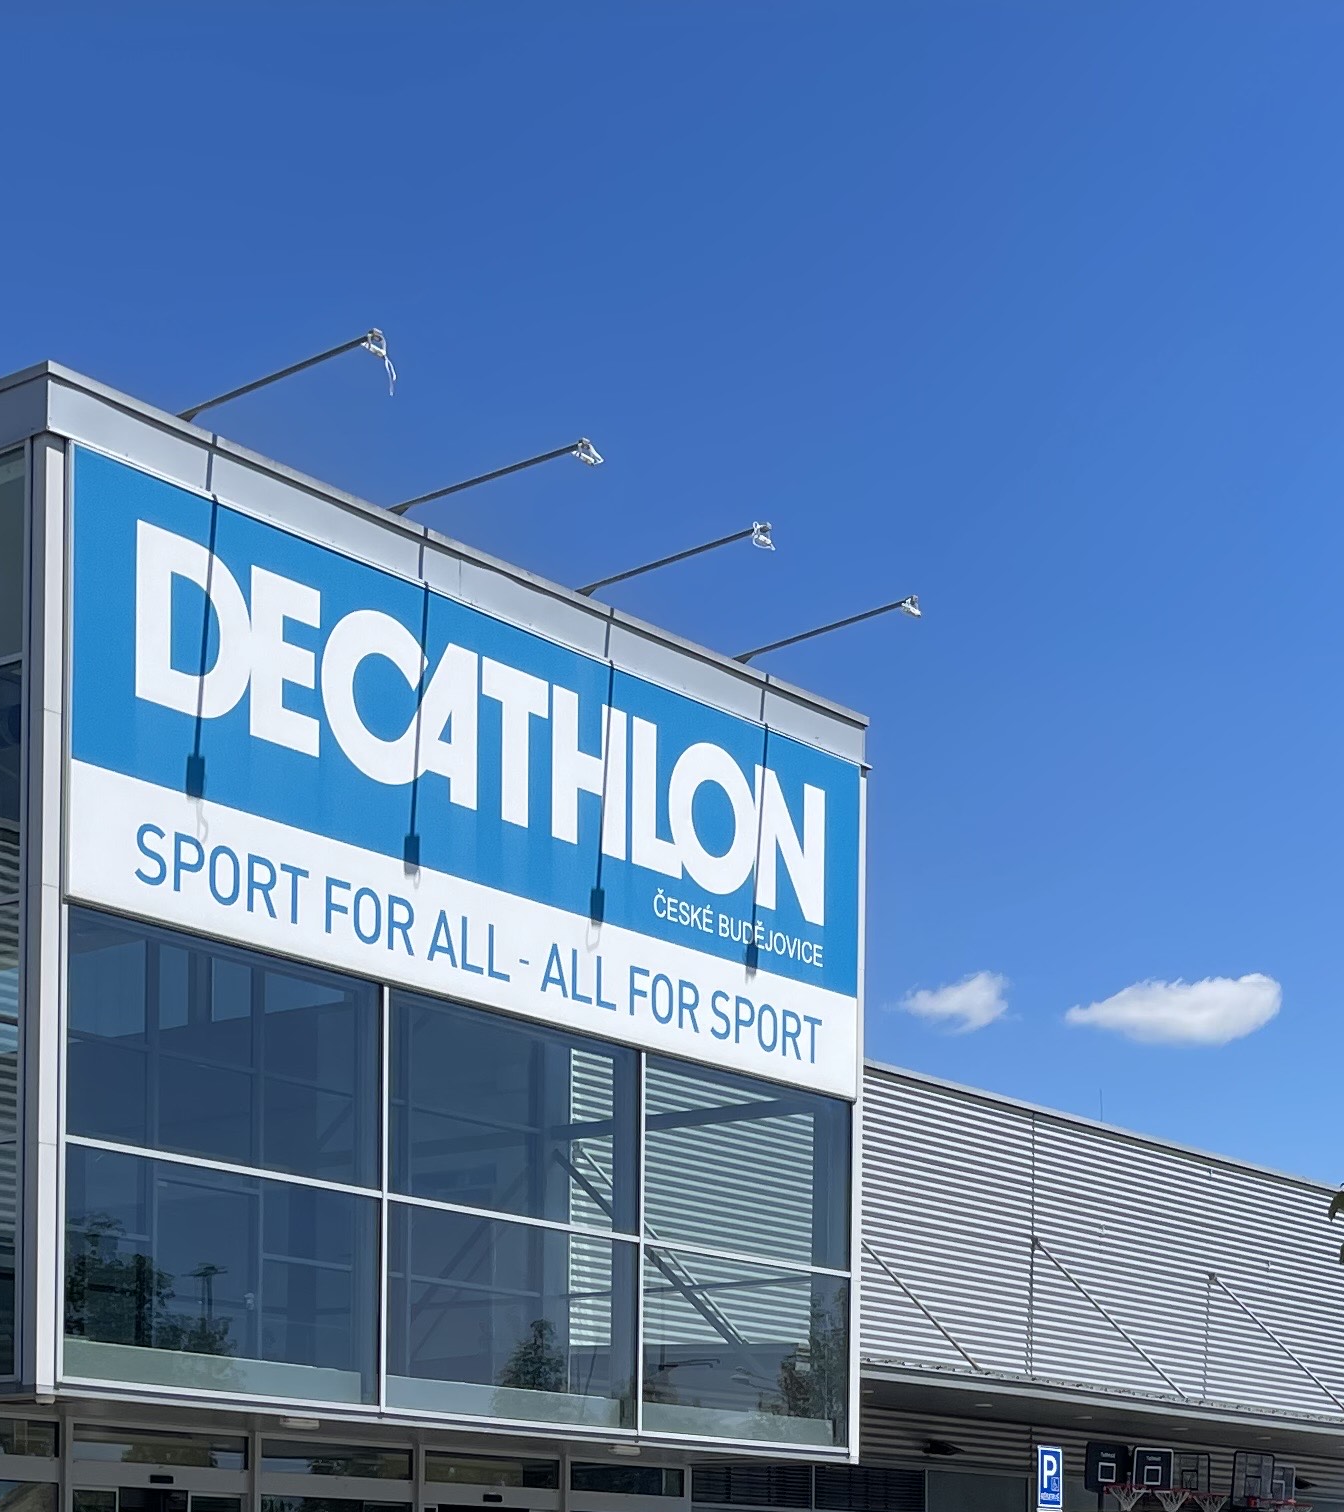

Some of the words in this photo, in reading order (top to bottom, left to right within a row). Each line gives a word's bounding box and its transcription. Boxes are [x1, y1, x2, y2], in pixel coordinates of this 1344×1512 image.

[135, 519, 825, 926] DECATHLON
[134, 823, 309, 925] SPORT
[325, 876, 414, 956] FOR
[427, 909, 510, 982] ALL
[540, 942, 616, 1011] ALL
[629, 964, 700, 1034] FOR
[710, 989, 823, 1064] SPORT
[653, 888, 714, 934] ČESKÉ
[718, 915, 824, 968] BUDĚJOVICE
[1043, 1454, 1057, 1489] P
